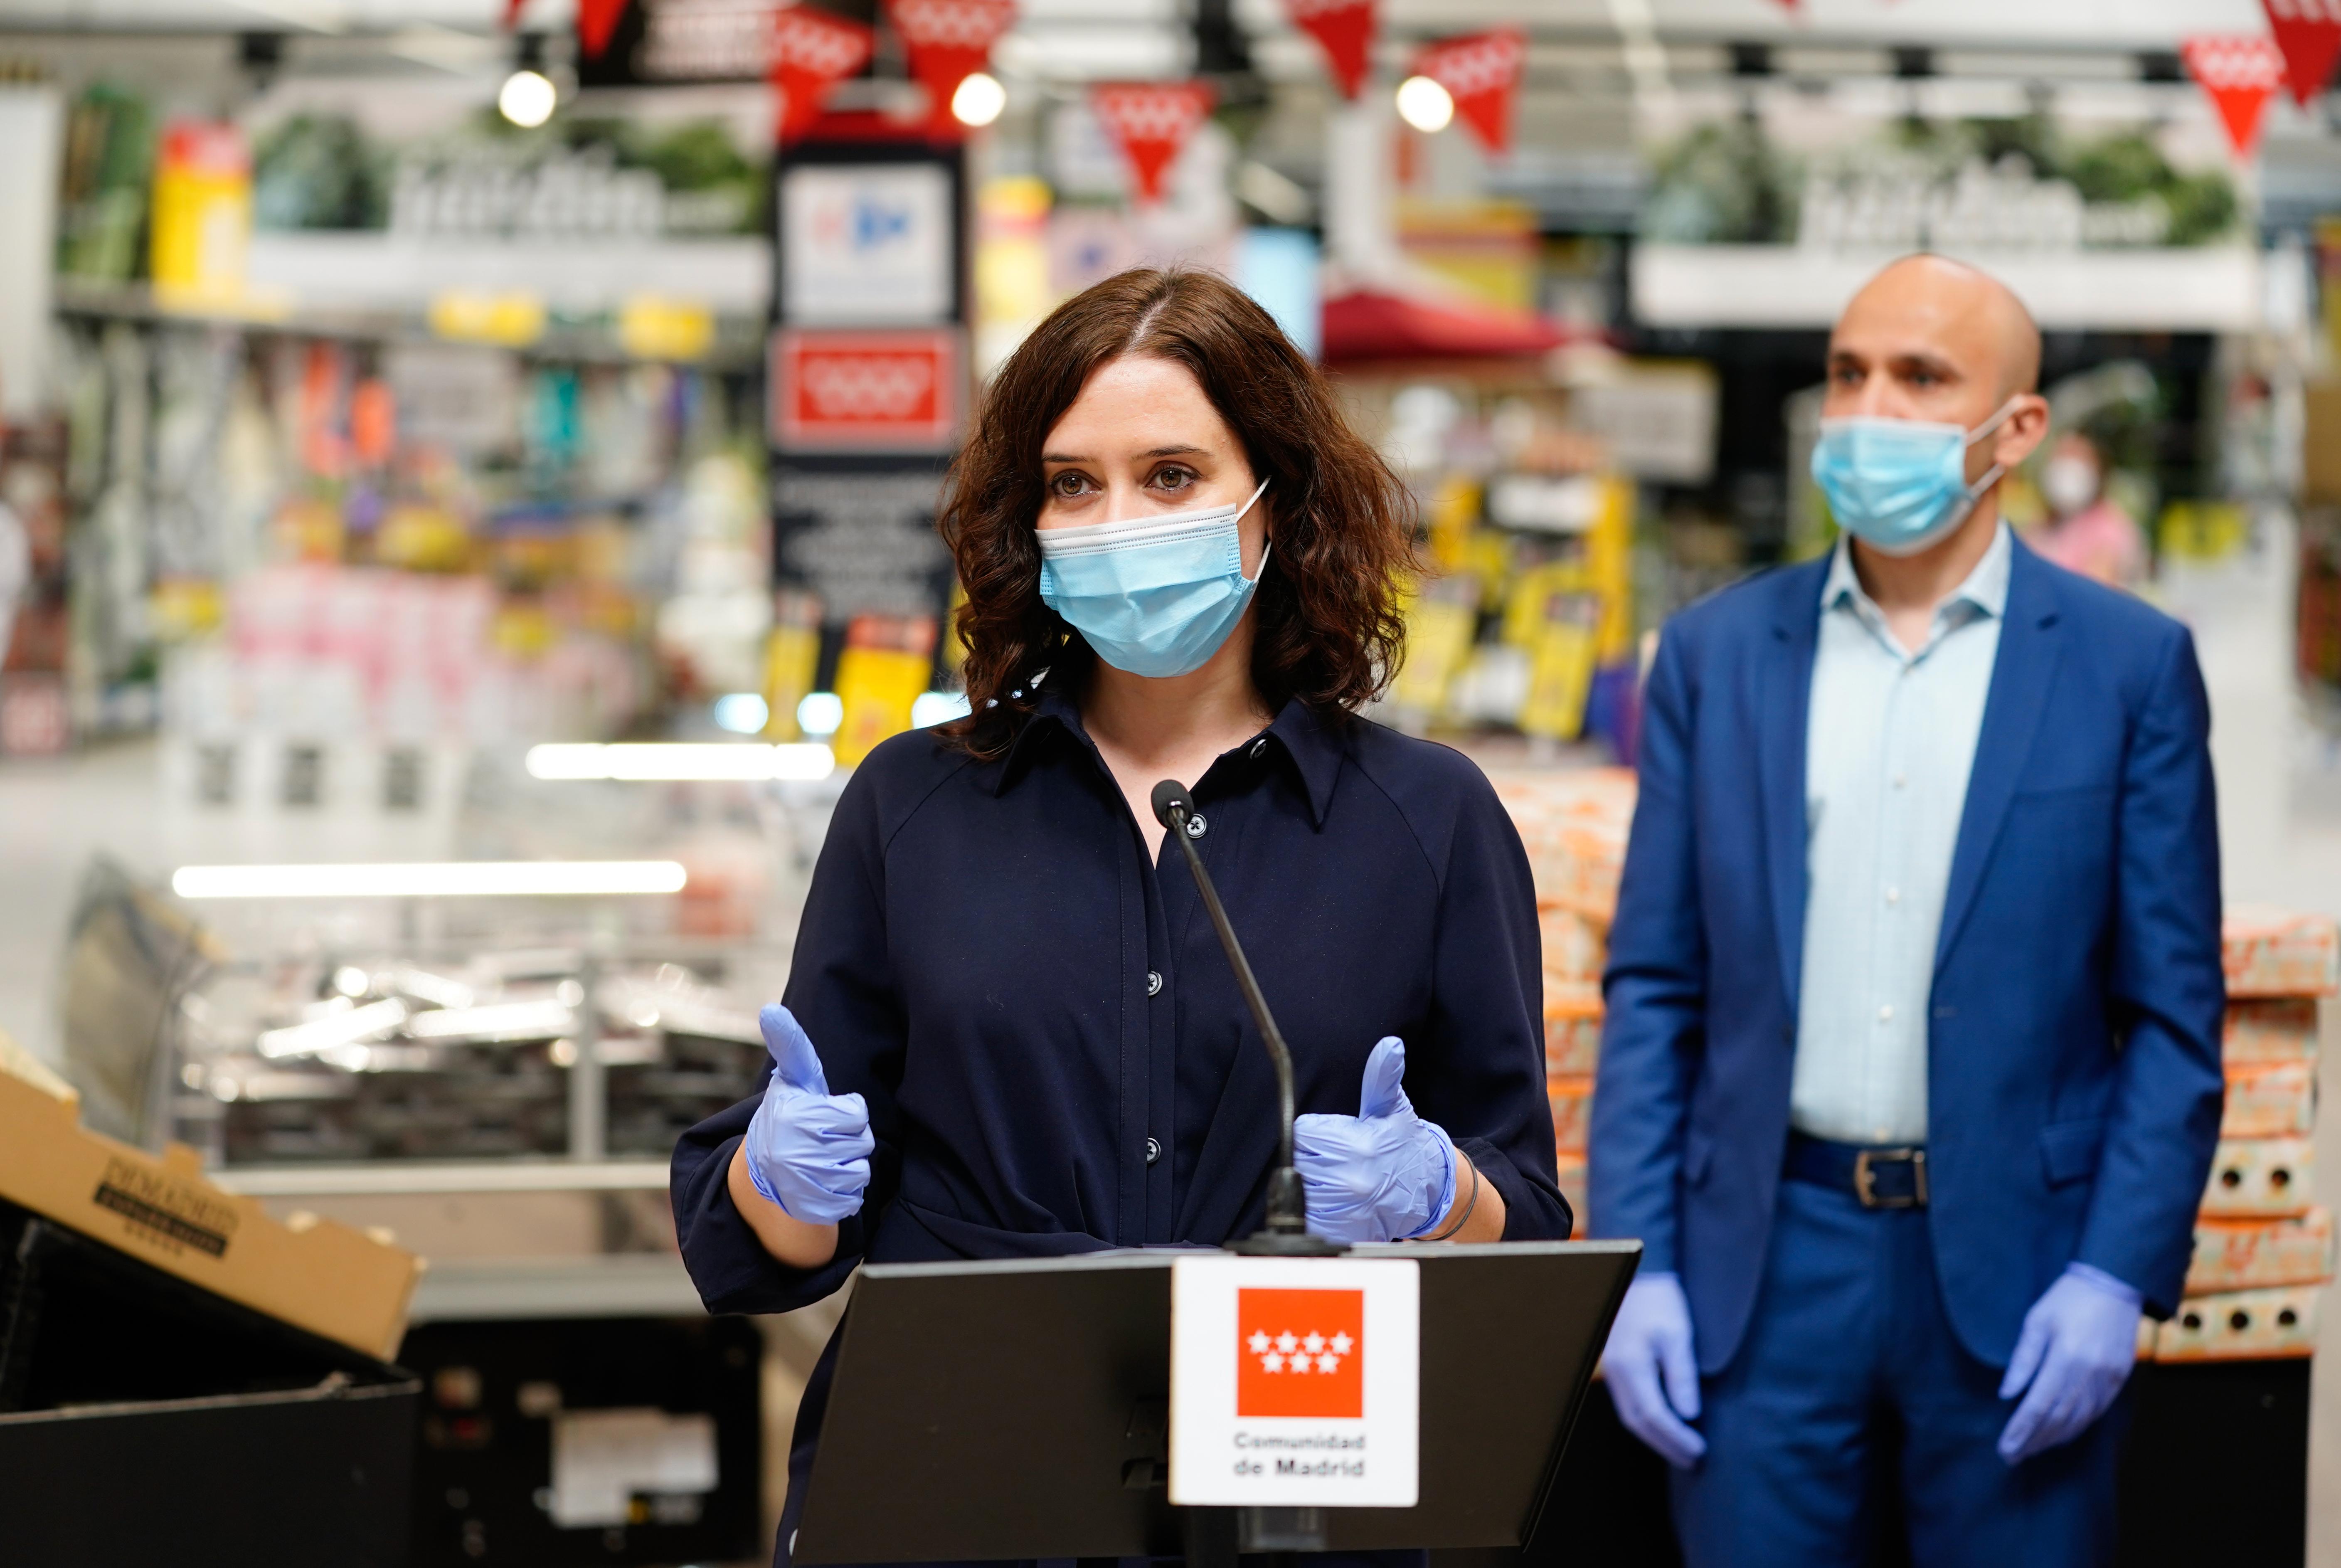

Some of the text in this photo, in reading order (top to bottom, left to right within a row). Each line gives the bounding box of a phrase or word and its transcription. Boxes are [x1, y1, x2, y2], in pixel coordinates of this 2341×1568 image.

[1234, 1432, 1365, 1450] Comunidad
[1234, 1456, 1364, 1477] de Madrid
